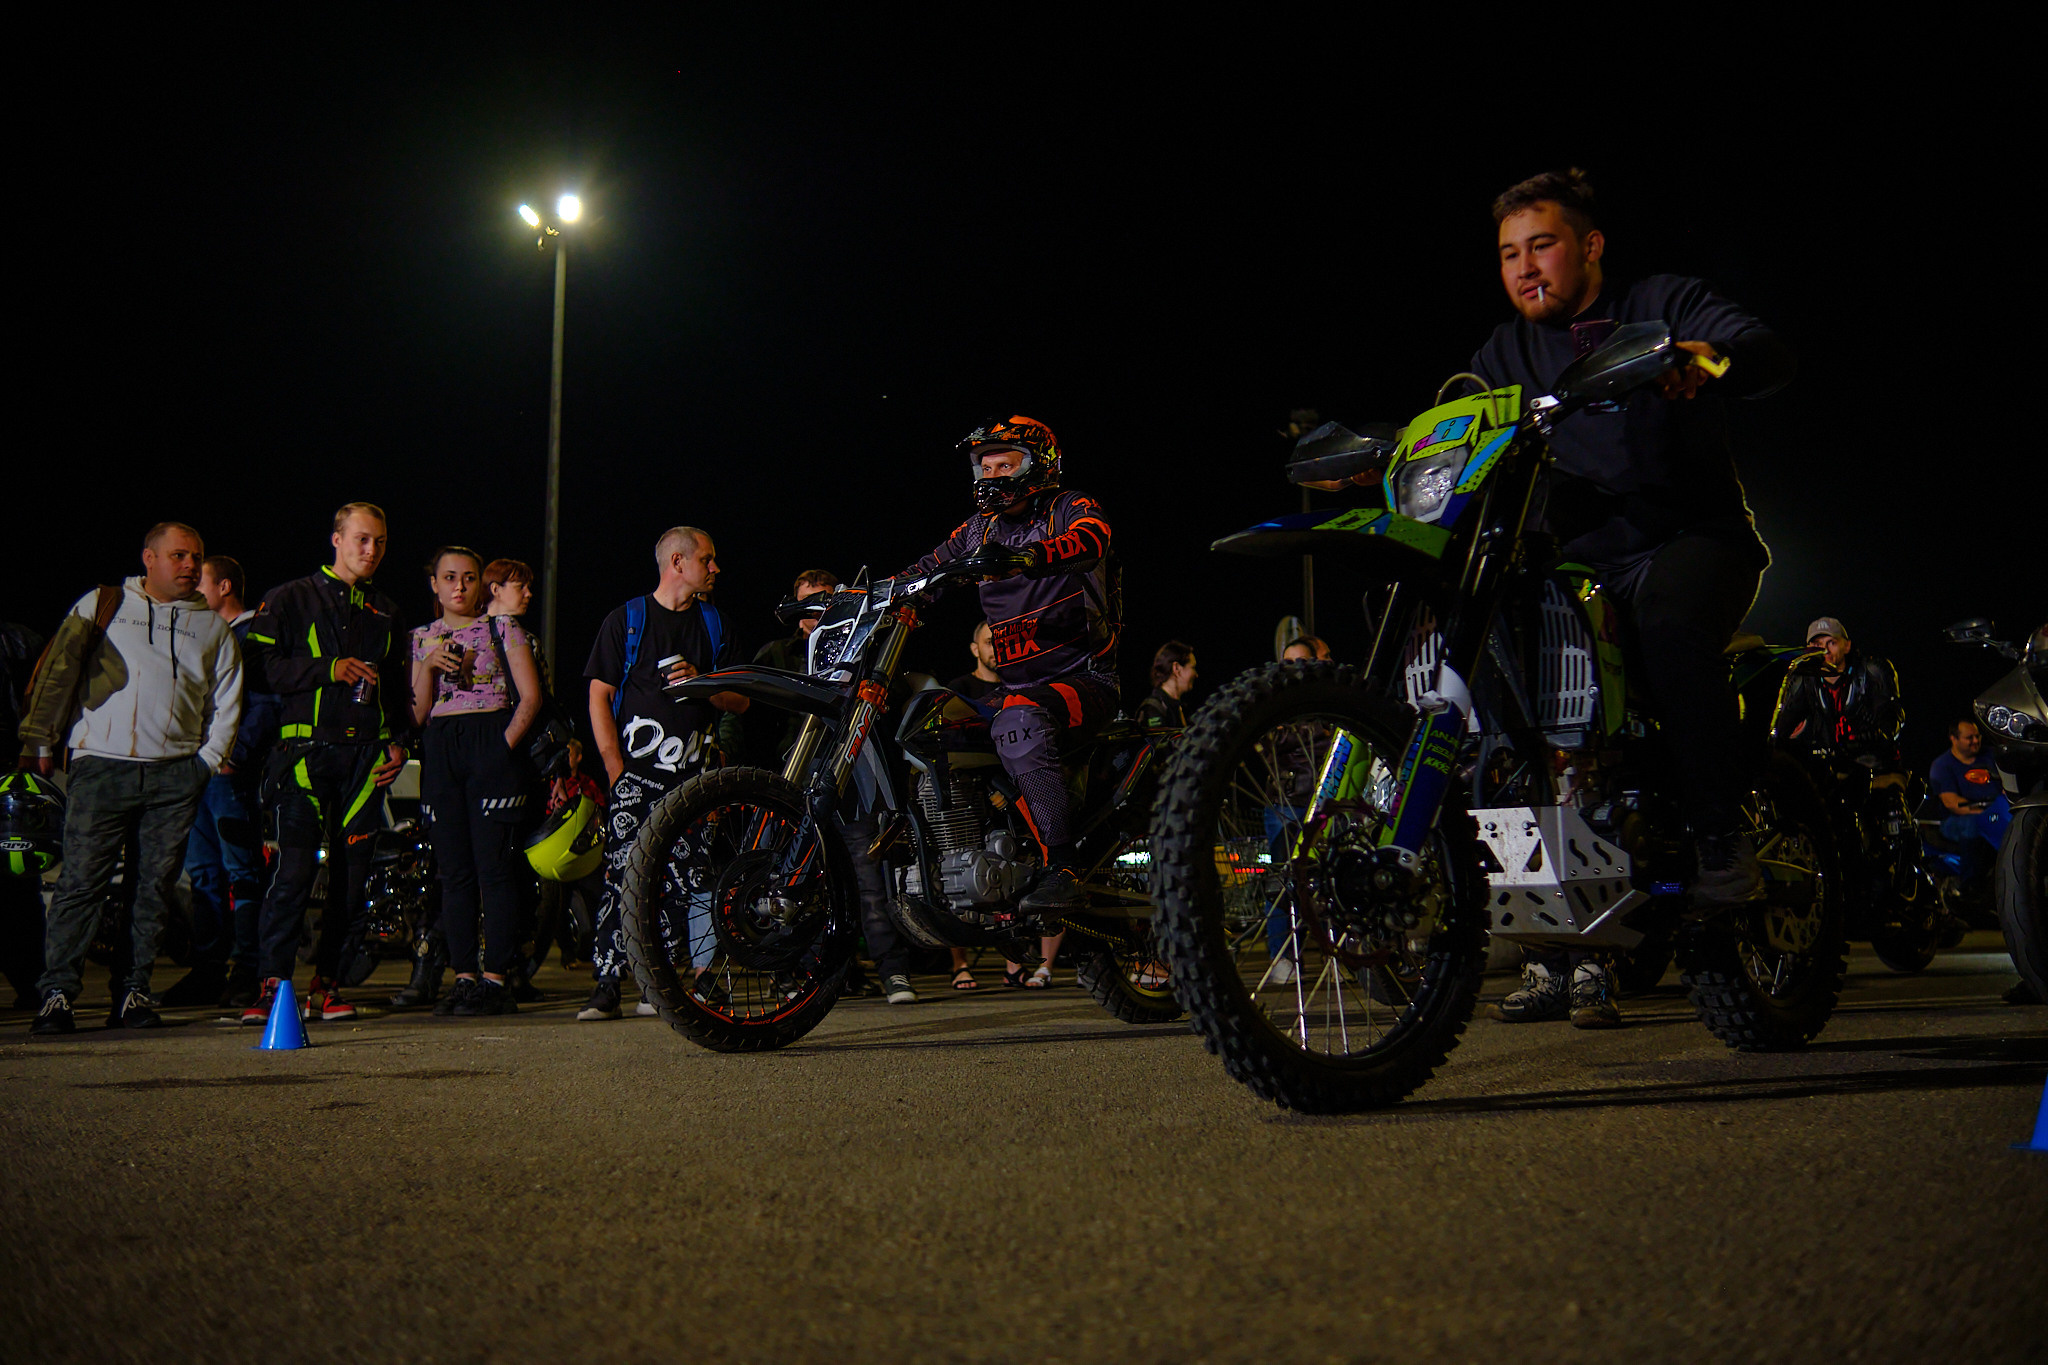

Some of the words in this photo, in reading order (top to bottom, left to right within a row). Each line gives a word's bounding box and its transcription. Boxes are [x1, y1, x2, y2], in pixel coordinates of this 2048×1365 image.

[1040, 530, 1088, 563] FOX
[994, 626, 1041, 663] FOX
[999, 727, 1032, 747] FOX
